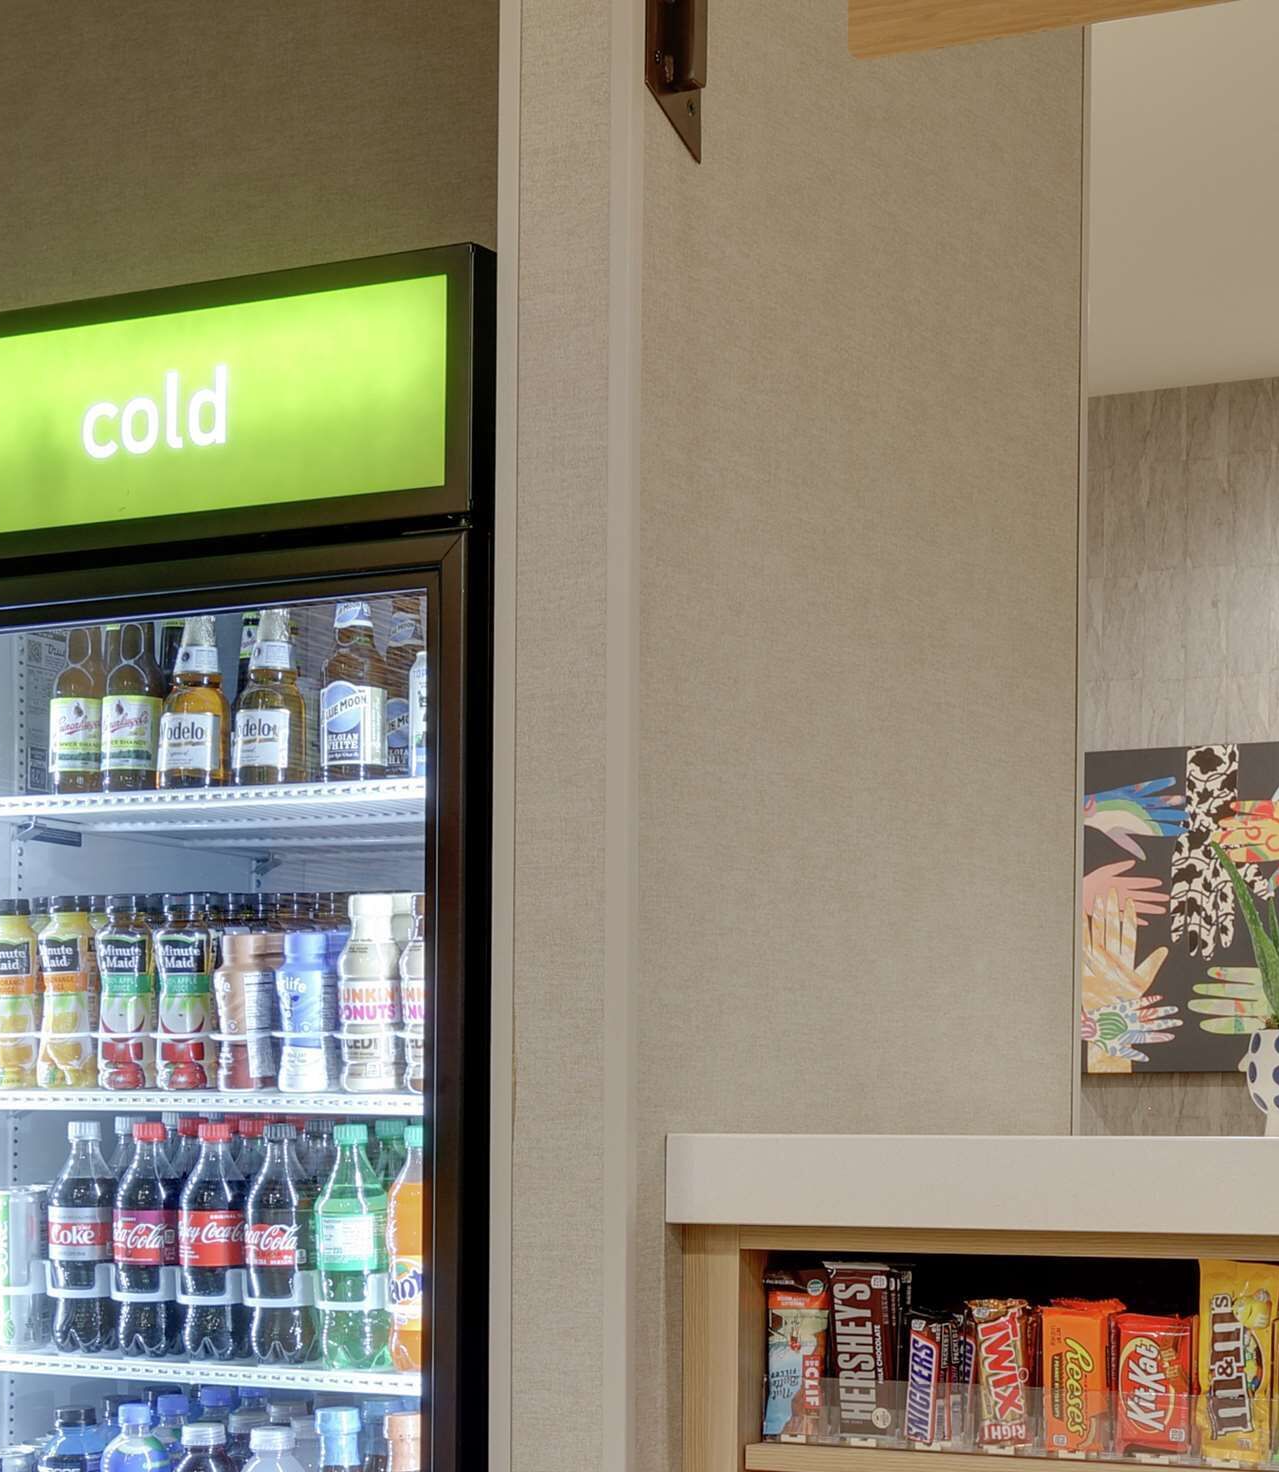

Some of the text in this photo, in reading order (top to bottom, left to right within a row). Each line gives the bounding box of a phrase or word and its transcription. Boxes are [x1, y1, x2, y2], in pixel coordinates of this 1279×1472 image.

[83, 365, 229, 460] cold
[51, 1223, 95, 1244] Coke
[805, 1367, 819, 1406] CLIF
[834, 1283, 877, 1421] HERSHEY'S
[874, 1325, 883, 1367] CHOCOLATE
[907, 1338, 934, 1440] SNICKERS
[978, 1310, 1024, 1420] TWIX
[1065, 1337, 1094, 1438] Reese's
[985, 1424, 1026, 1440] RIGHT
